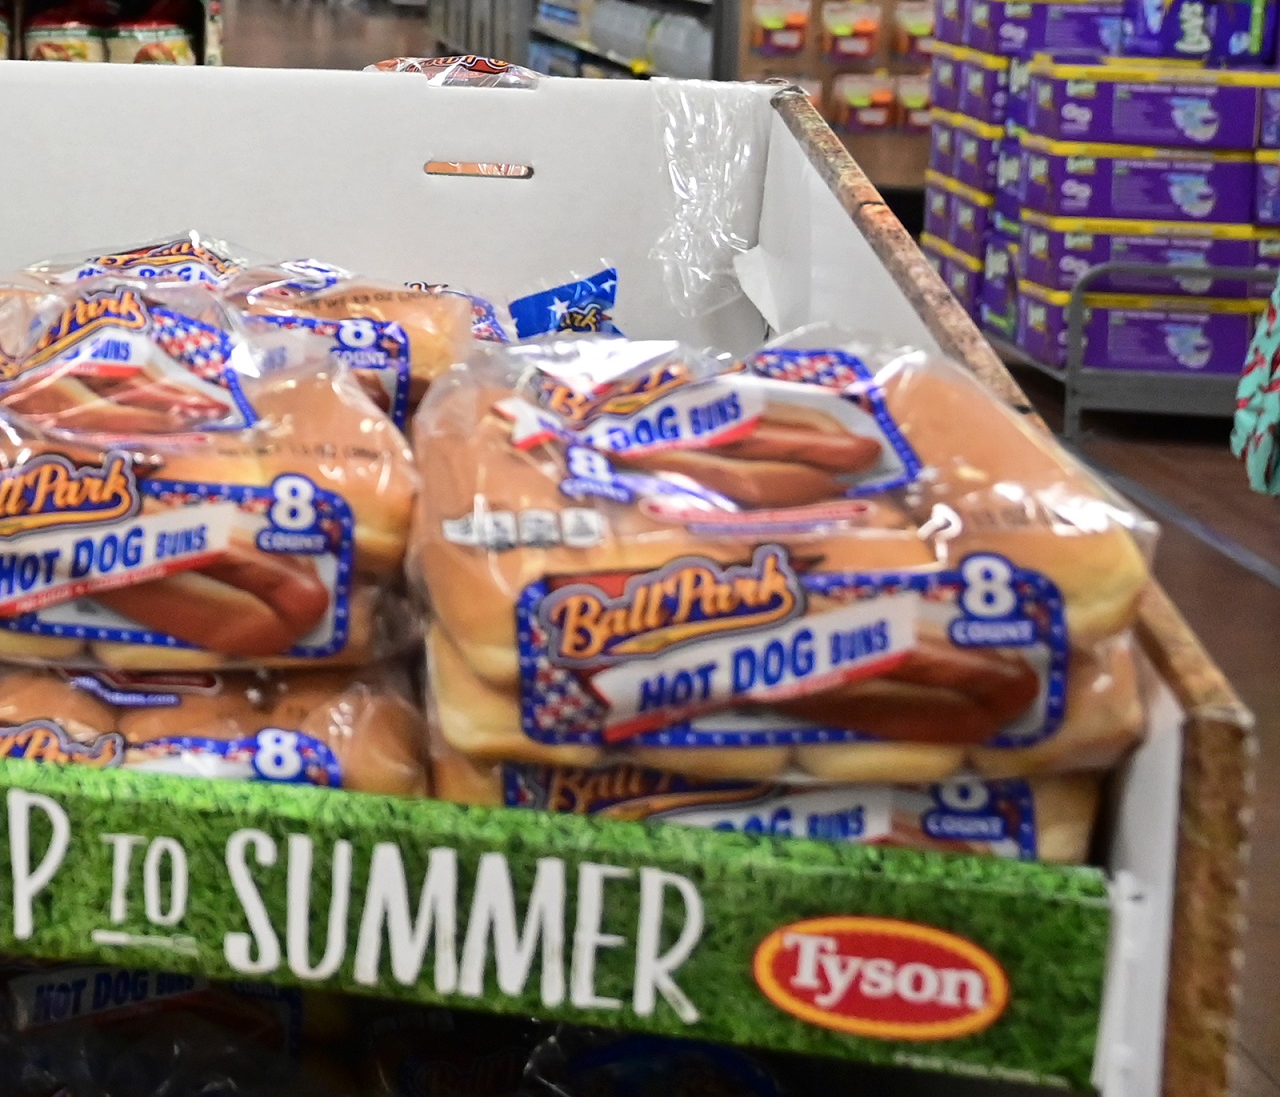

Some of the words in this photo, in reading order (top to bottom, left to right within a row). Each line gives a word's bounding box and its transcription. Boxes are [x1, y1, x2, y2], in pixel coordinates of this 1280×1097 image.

[607, 407, 681, 453] DOG
[27, 458, 131, 514] Park
[270, 475, 317, 531] 8
[70, 528, 144, 578] DOG
[154, 524, 208, 559] BUNS
[549, 581, 662, 660] Ball
[662, 555, 795, 624] Park
[960, 557, 1017, 619] 8
[952, 620, 1036, 645] COUNT
[640, 663, 718, 711] HOT
[732, 629, 816, 693] DOG
[255, 729, 304, 778] 8
[926, 813, 1005, 837] COUNT
[99, 832, 191, 928] TO
[222, 827, 708, 1026] SUMMER
[93, 967, 151, 1007] DOG
[783, 931, 990, 1012] Tyson
